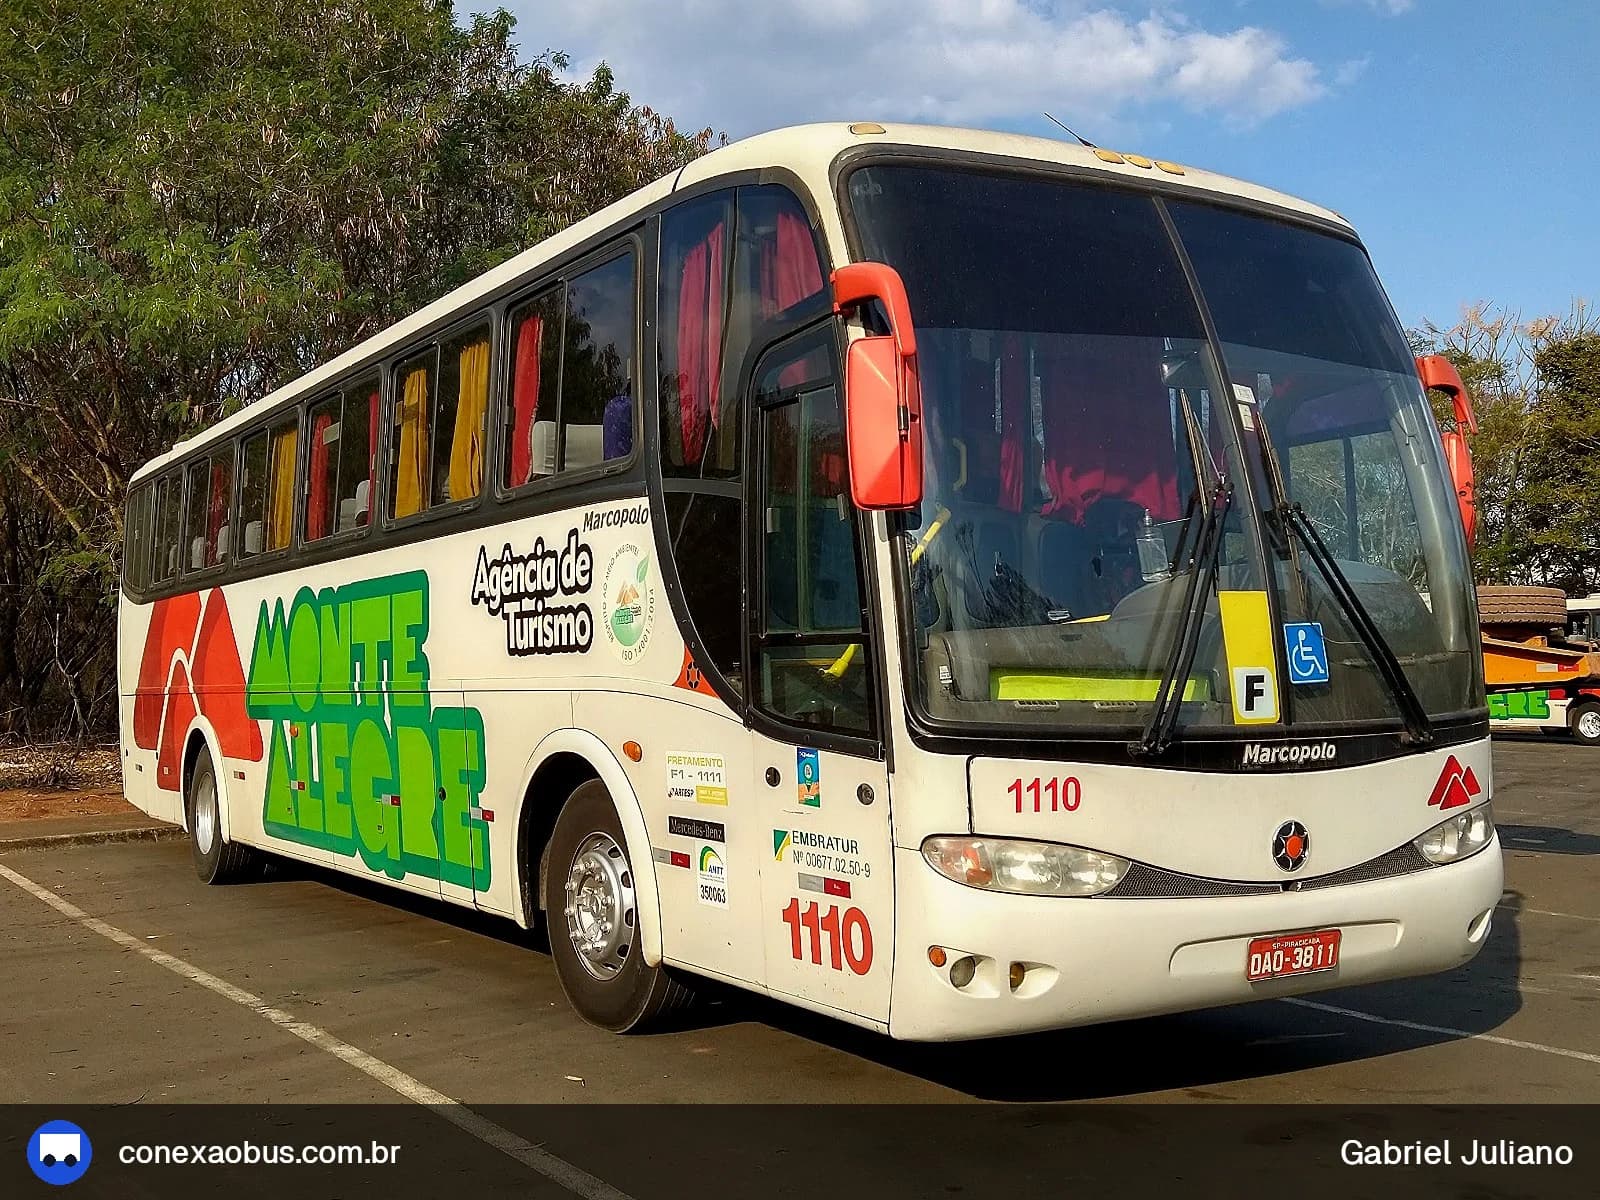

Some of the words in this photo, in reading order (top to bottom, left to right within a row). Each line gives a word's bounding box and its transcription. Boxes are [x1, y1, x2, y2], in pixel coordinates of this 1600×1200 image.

[583, 504, 649, 533] Marcopolo
[473, 539, 557, 613] Agência
[560, 531, 593, 593] de
[503, 600, 592, 651] Turismo
[248, 584, 427, 714] MONTE
[621, 649, 633, 661] ISO
[1244, 675, 1265, 711] F
[666, 755, 724, 768] FRETAMENTO
[1242, 742, 1337, 764] Marcopolo
[670, 769, 684, 780] F1
[697, 770, 722, 783] 1111
[264, 716, 485, 871] ALEGRE
[1007, 776, 1082, 813] 1110
[671, 818, 723, 841] Mercedes-Benz
[792, 830, 859, 855] EMBRATUR
[708, 864, 724, 875] ANTT
[805, 852, 871, 878] 00677.02.50-9
[700, 884, 726, 904] 350063
[782, 897, 873, 976] 1110
